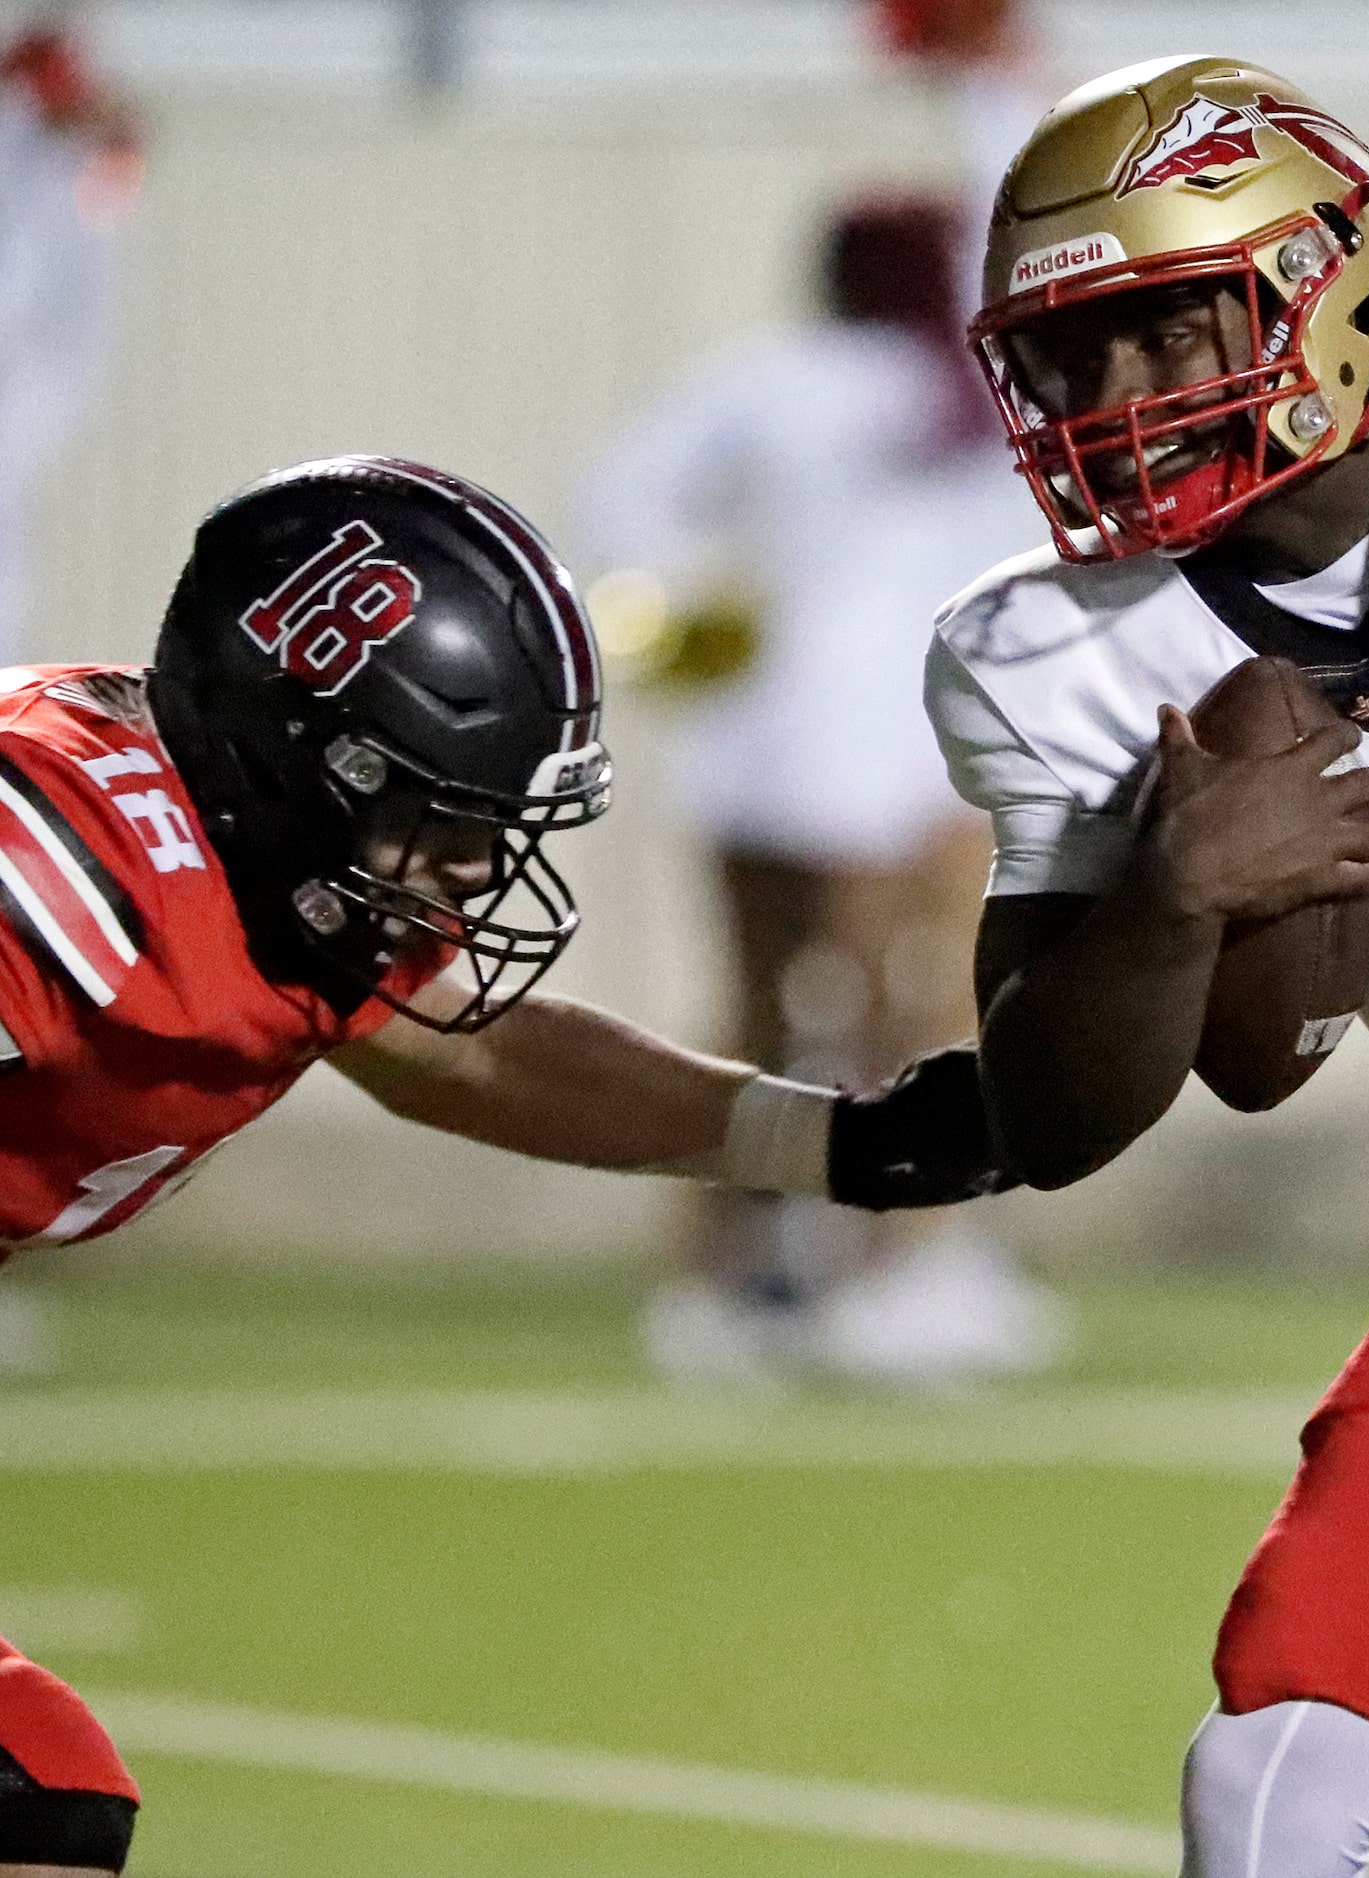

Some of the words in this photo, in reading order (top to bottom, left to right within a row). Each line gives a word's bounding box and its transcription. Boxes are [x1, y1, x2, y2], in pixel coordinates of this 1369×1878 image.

[1017, 242, 1104, 282] Riddell
[1261, 320, 1290, 364] dell
[239, 518, 422, 697] 18
[79, 746, 207, 873] 18
